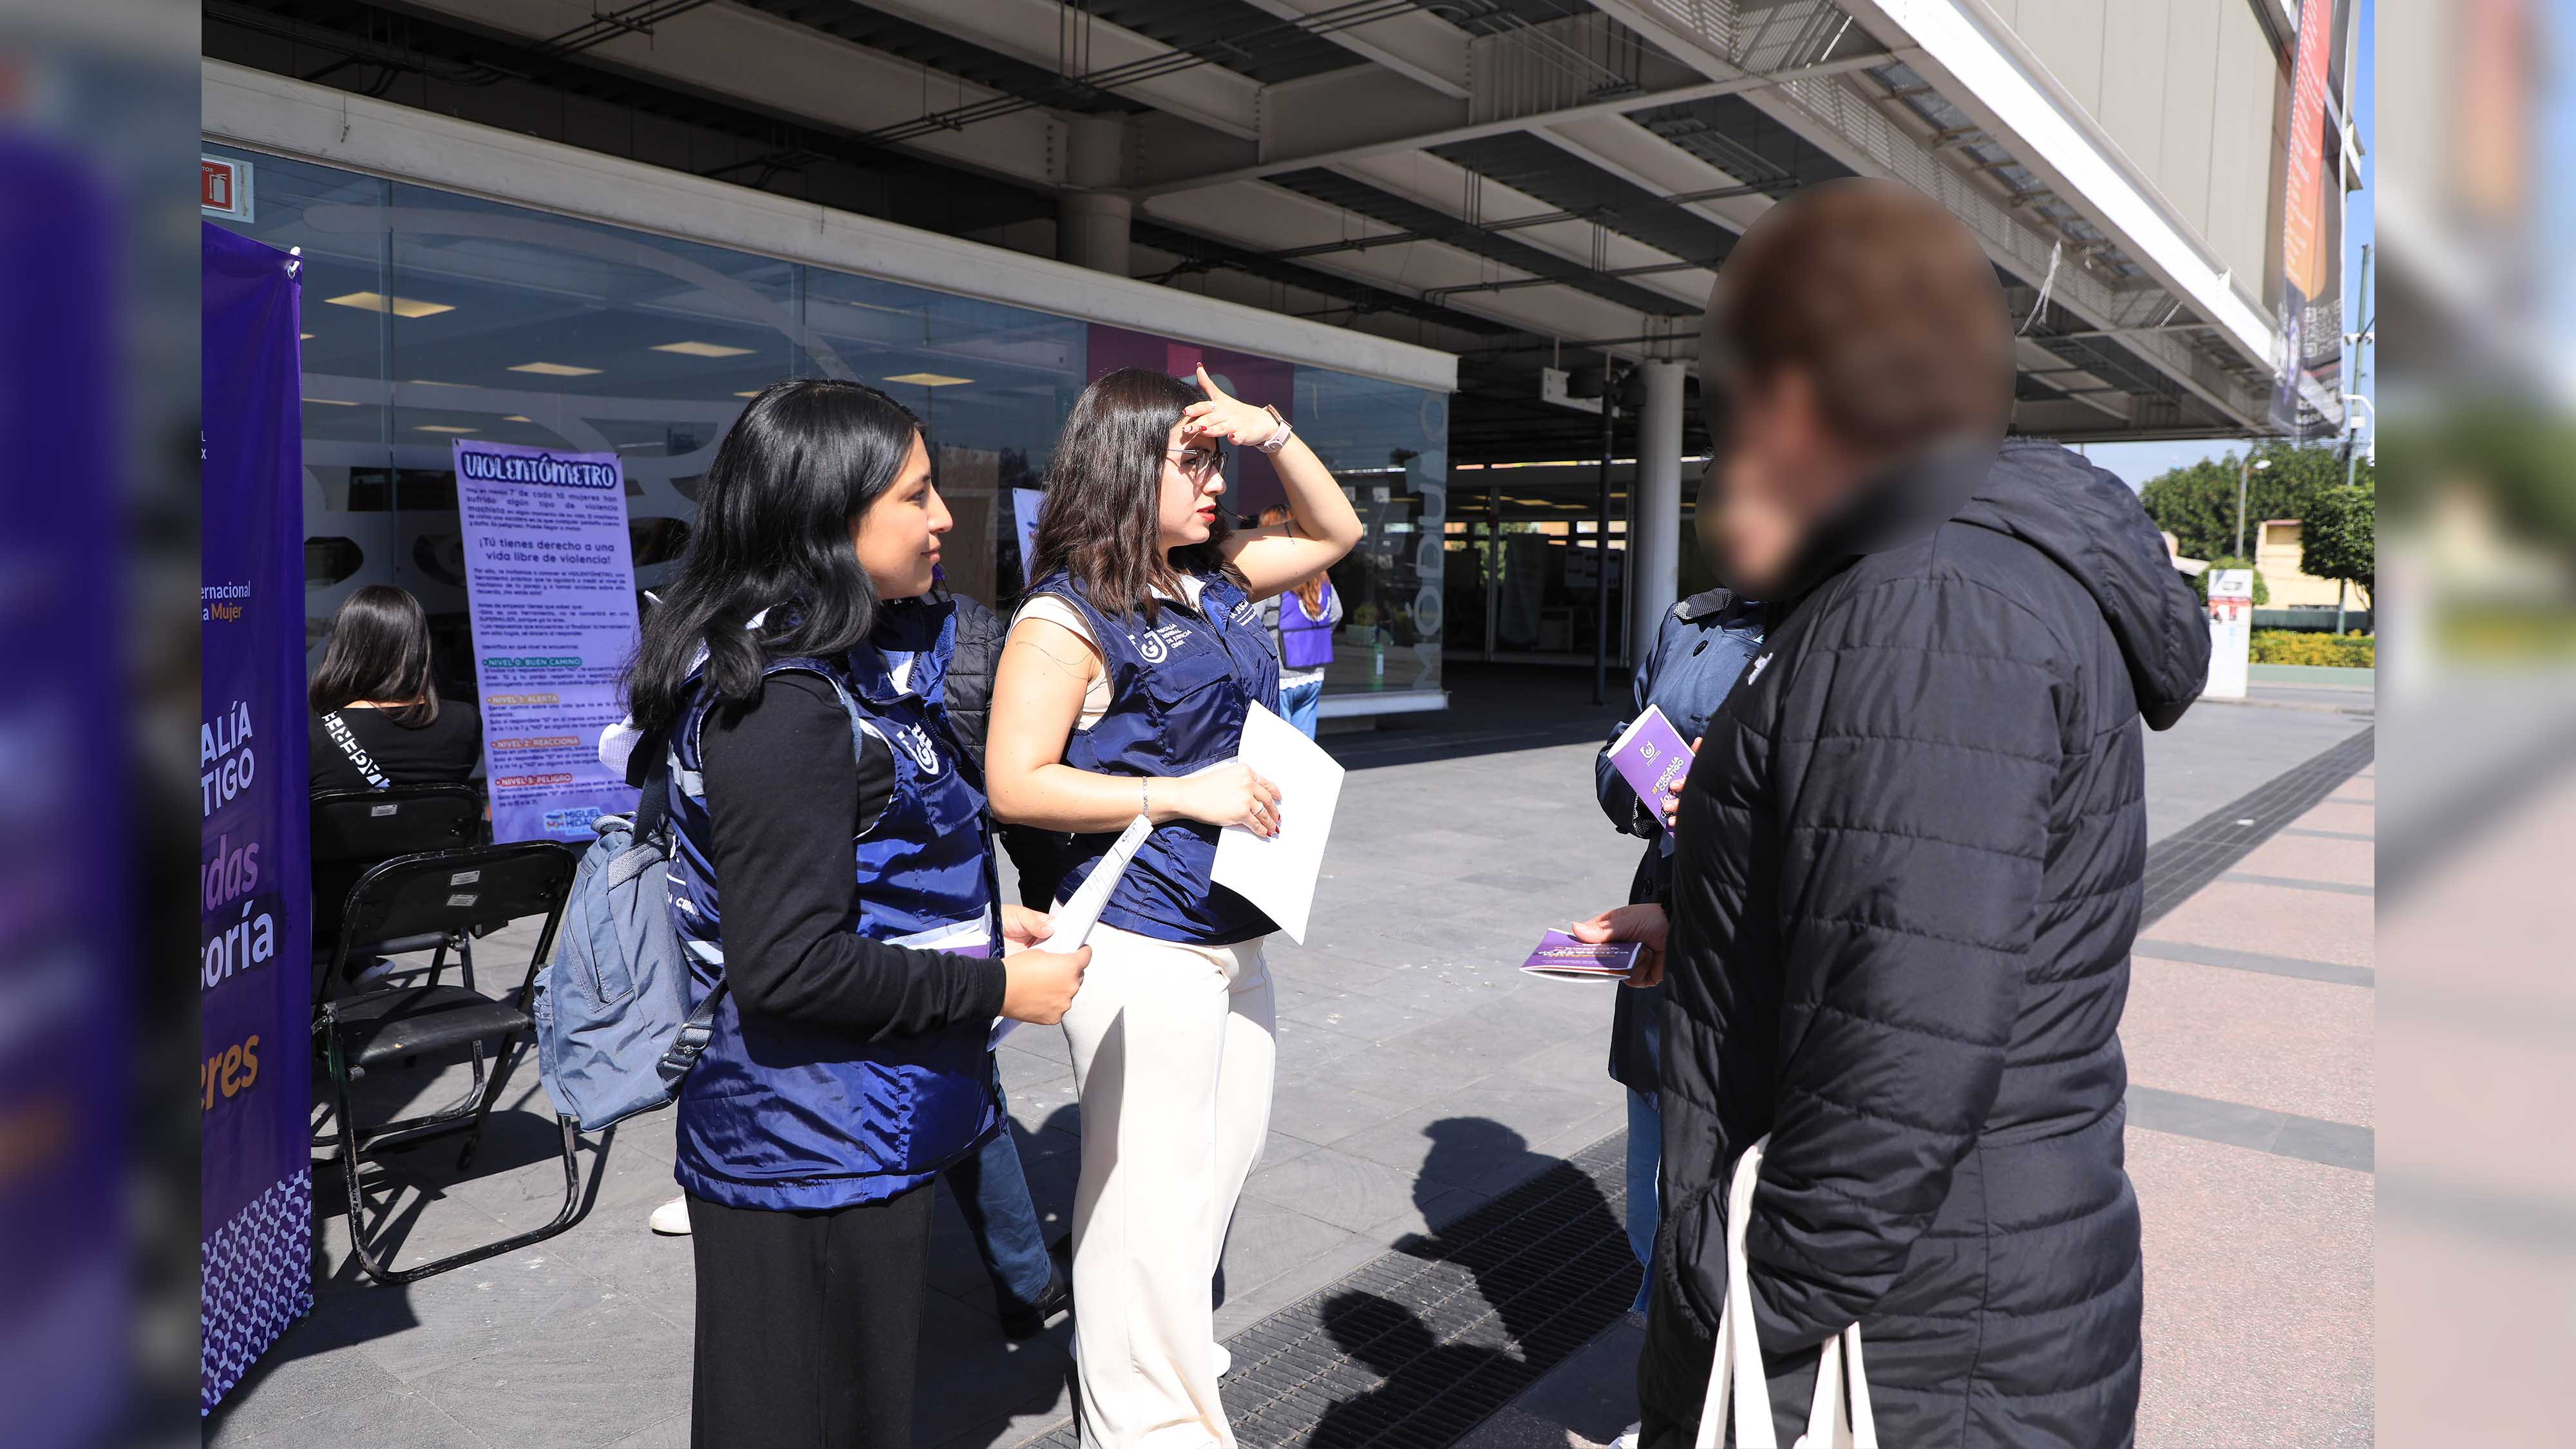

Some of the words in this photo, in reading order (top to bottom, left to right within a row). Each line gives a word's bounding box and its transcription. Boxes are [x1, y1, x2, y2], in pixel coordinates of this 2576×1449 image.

[463, 453, 615, 488] VIOLENTÓMETRO
[468, 506, 505, 514] machista
[479, 537, 496, 549] ¡Tú
[500, 538, 533, 549] tienes
[536, 538, 581, 551] derecho
[595, 544, 614, 553] una
[1406, 393, 1448, 690] MÓDUO
[486, 551, 511, 561] vida
[514, 551, 540, 562] libre
[542, 554, 556, 563] de
[560, 554, 611, 565] violencia!
[211, 601, 242, 622] Mujer
[488, 658, 512, 667] NIVEL
[501, 777, 527, 786] NIVEL
[536, 774, 572, 783] PELIGRO
[1651, 755, 1680, 794] #FISCALÍA
[1660, 759, 1685, 791] CONTIGO
[566, 818, 592, 828] HIDA
